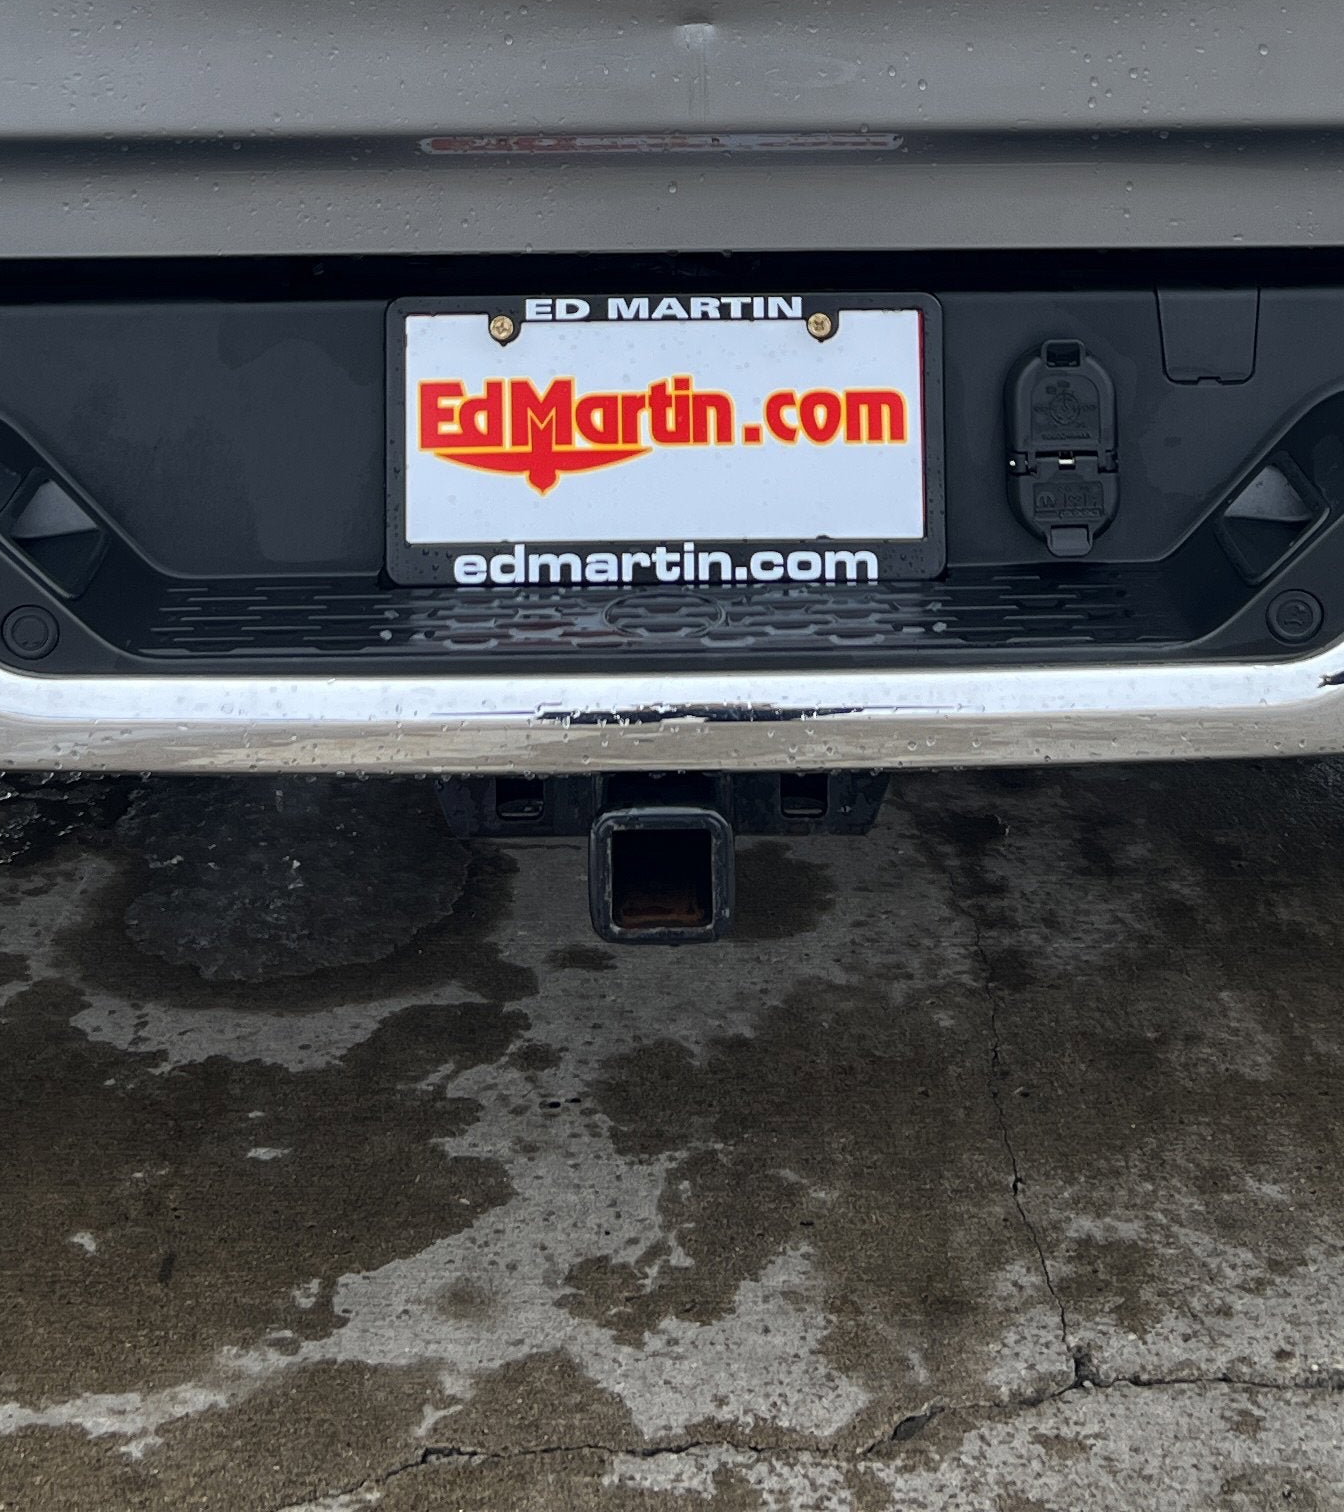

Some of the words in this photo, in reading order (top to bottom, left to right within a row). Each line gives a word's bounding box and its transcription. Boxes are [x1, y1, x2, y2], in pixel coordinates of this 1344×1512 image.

[525, 298, 590, 321] ED
[607, 296, 803, 320] MARTIN
[418, 377, 908, 448] EdMartin.com
[454, 544, 879, 584] edmartin.com
